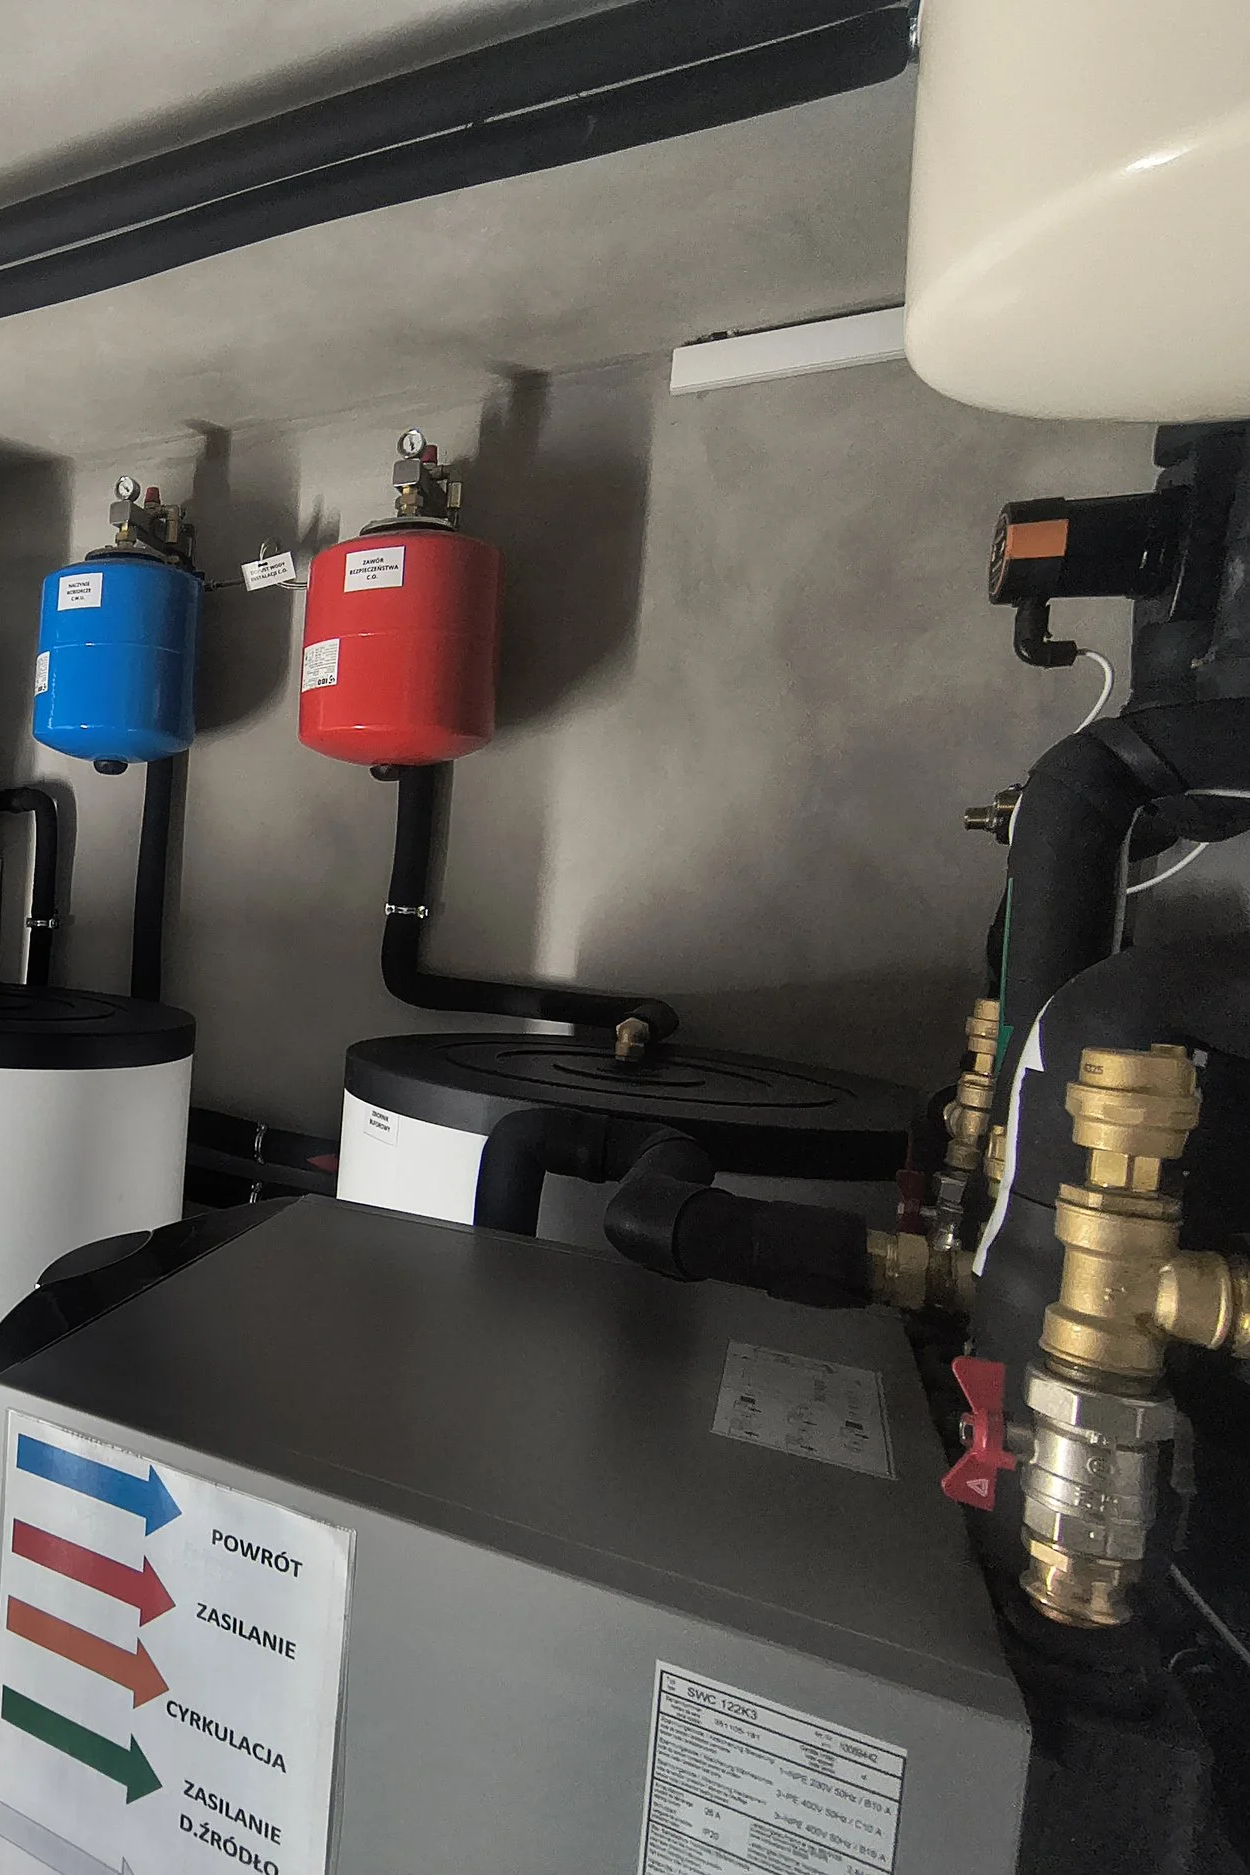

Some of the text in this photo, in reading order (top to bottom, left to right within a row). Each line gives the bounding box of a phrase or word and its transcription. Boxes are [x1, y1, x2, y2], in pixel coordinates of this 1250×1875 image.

[350, 564, 399, 576] BEZPIECZEŃSTWA
[363, 557, 384, 566] ZAWÓR
[211, 1529, 302, 1577] POWRÓT
[196, 1602, 297, 1660] ZASILANIE
[686, 1685, 716, 1706] SWC
[721, 1698, 758, 1721] 122K3
[166, 1700, 287, 1773] CYRKULACJA
[183, 1779, 282, 1845] ZASILANIE
[179, 1813, 279, 1875] D.ŹRÓDŁO
